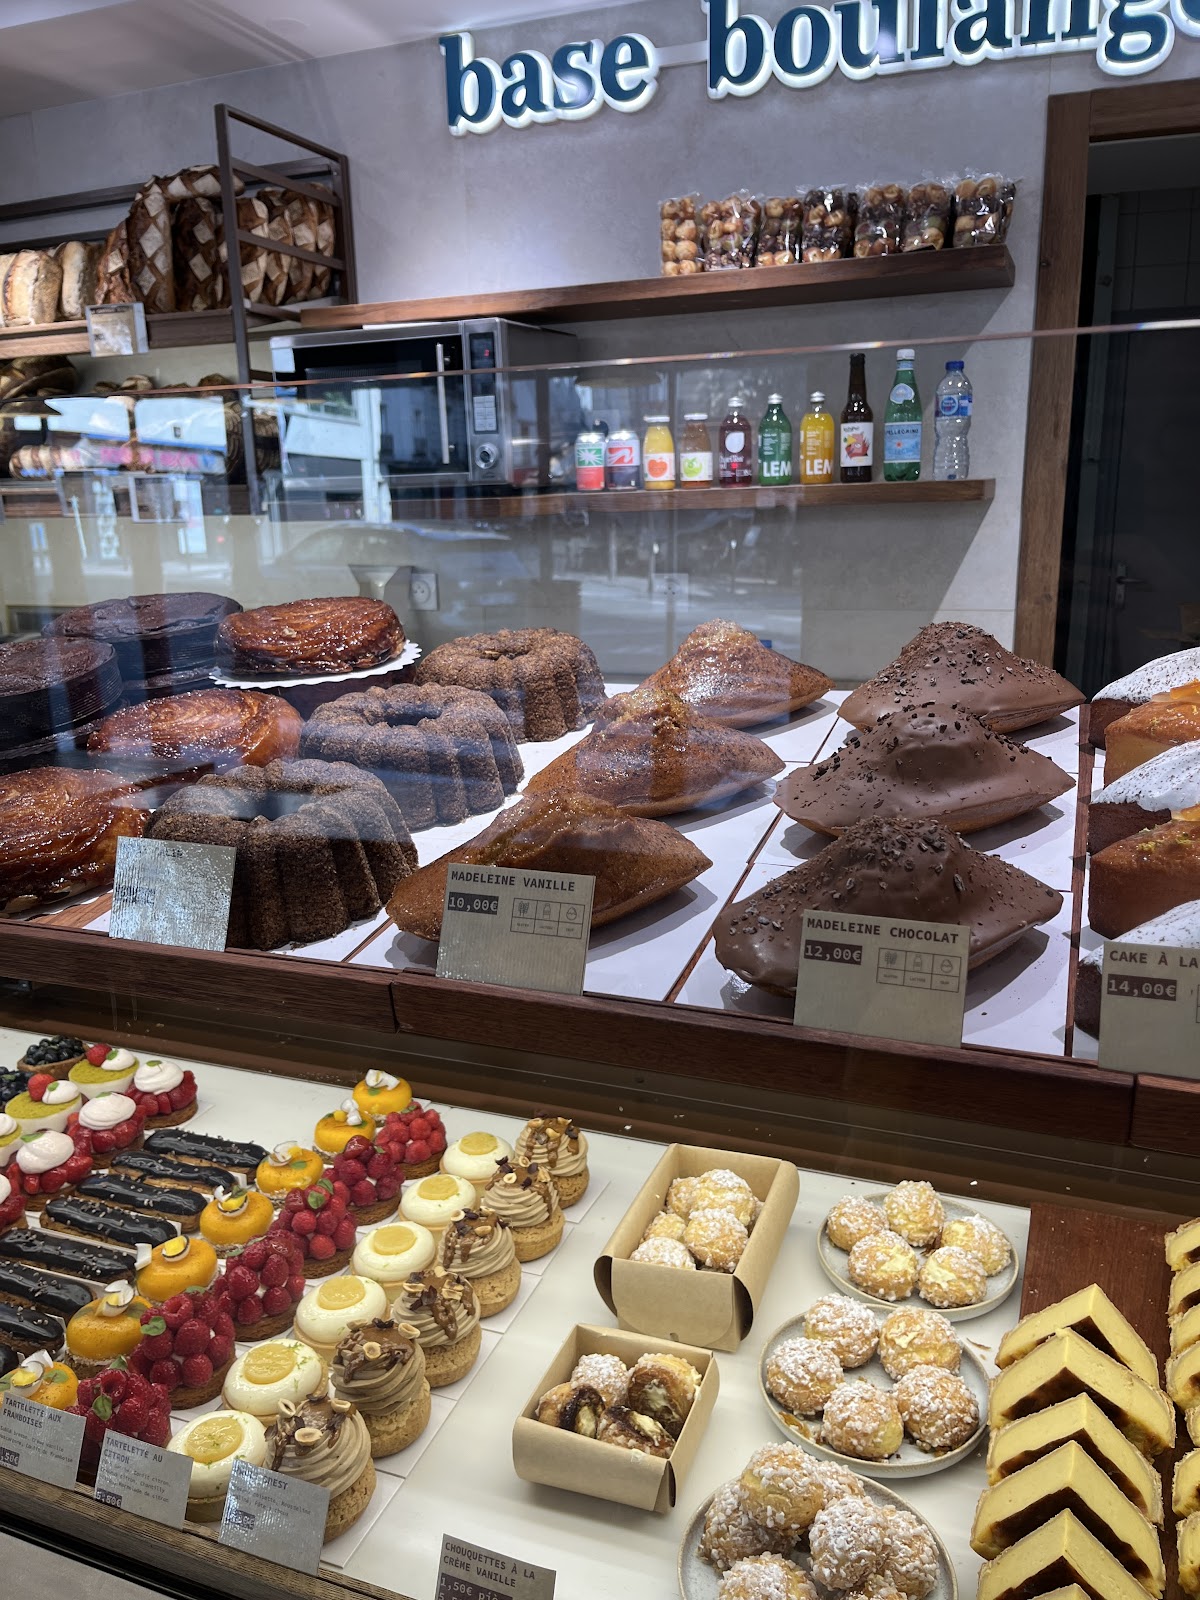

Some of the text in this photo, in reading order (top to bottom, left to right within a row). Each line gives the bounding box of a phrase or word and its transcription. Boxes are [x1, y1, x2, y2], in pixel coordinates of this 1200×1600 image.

[438, 0, 1200, 132] base boulang
[451, 870, 575, 892] MADELEINE VANILLE
[449, 896, 498, 912] 10,00€
[807, 917, 959, 944] MADELEINE CHOCOLAT
[805, 945, 861, 962] 12,00€
[1109, 950, 1199, 969] CAKE À LA
[1108, 979, 1176, 997] 14,00€
[3, 1408, 43, 1428] FRAMBOISES
[5, 1397, 62, 1423] TARTELETTE AUX
[103, 1448, 130, 1464] CITRON
[106, 1437, 163, 1463] TARTELETTE AU
[443, 1554, 517, 1588] CRÈME VANILLE
[445, 1541, 535, 1580] CHOUQUETTES À LA
[440, 1577, 473, 1596] 1,50€
